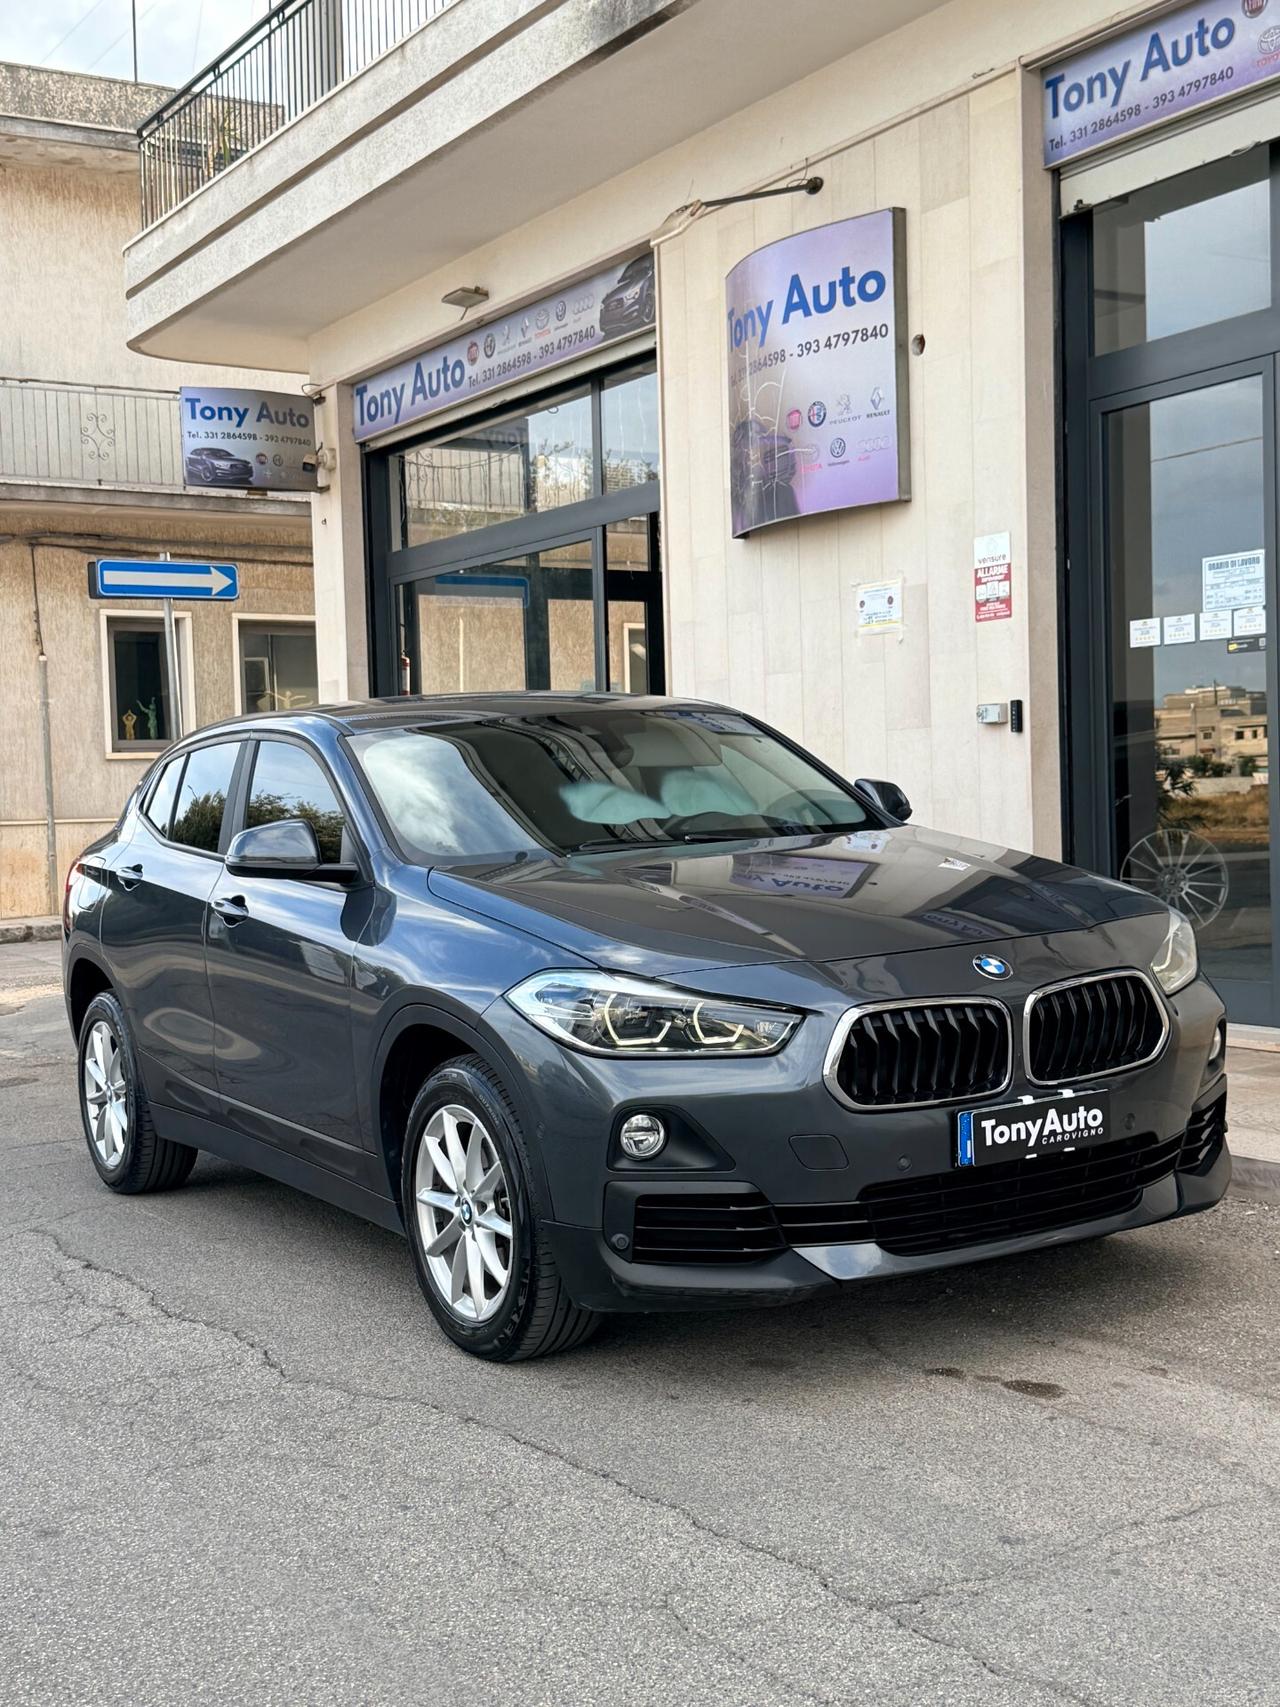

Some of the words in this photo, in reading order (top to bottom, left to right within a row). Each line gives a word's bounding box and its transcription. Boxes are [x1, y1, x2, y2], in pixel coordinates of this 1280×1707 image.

[1045, 59, 1131, 119] Tony
[1140, 17, 1235, 82] Auto
[1049, 138, 1067, 152] Tel.
[1070, 126, 1088, 143] 331
[1091, 104, 1142, 135] 2864598
[1152, 91, 1175, 110] 393
[1178, 66, 1234, 99] 4797840
[727, 300, 774, 352] Tony
[782, 266, 886, 325] Auto
[483, 368, 496, 382] 331
[497, 353, 532, 376] 2864598
[539, 342, 554, 359] 393
[557, 325, 595, 351] 4797840
[797, 339, 820, 358] 393
[824, 323, 889, 350] 4797840
[185, 398, 250, 428] Tony
[256, 401, 310, 428] Auto
[356, 382, 405, 426] Tony
[411, 355, 465, 406] Auto
[187, 431, 202, 439] Tel.
[1042, 1127, 1104, 1145] CAROVIGNO
